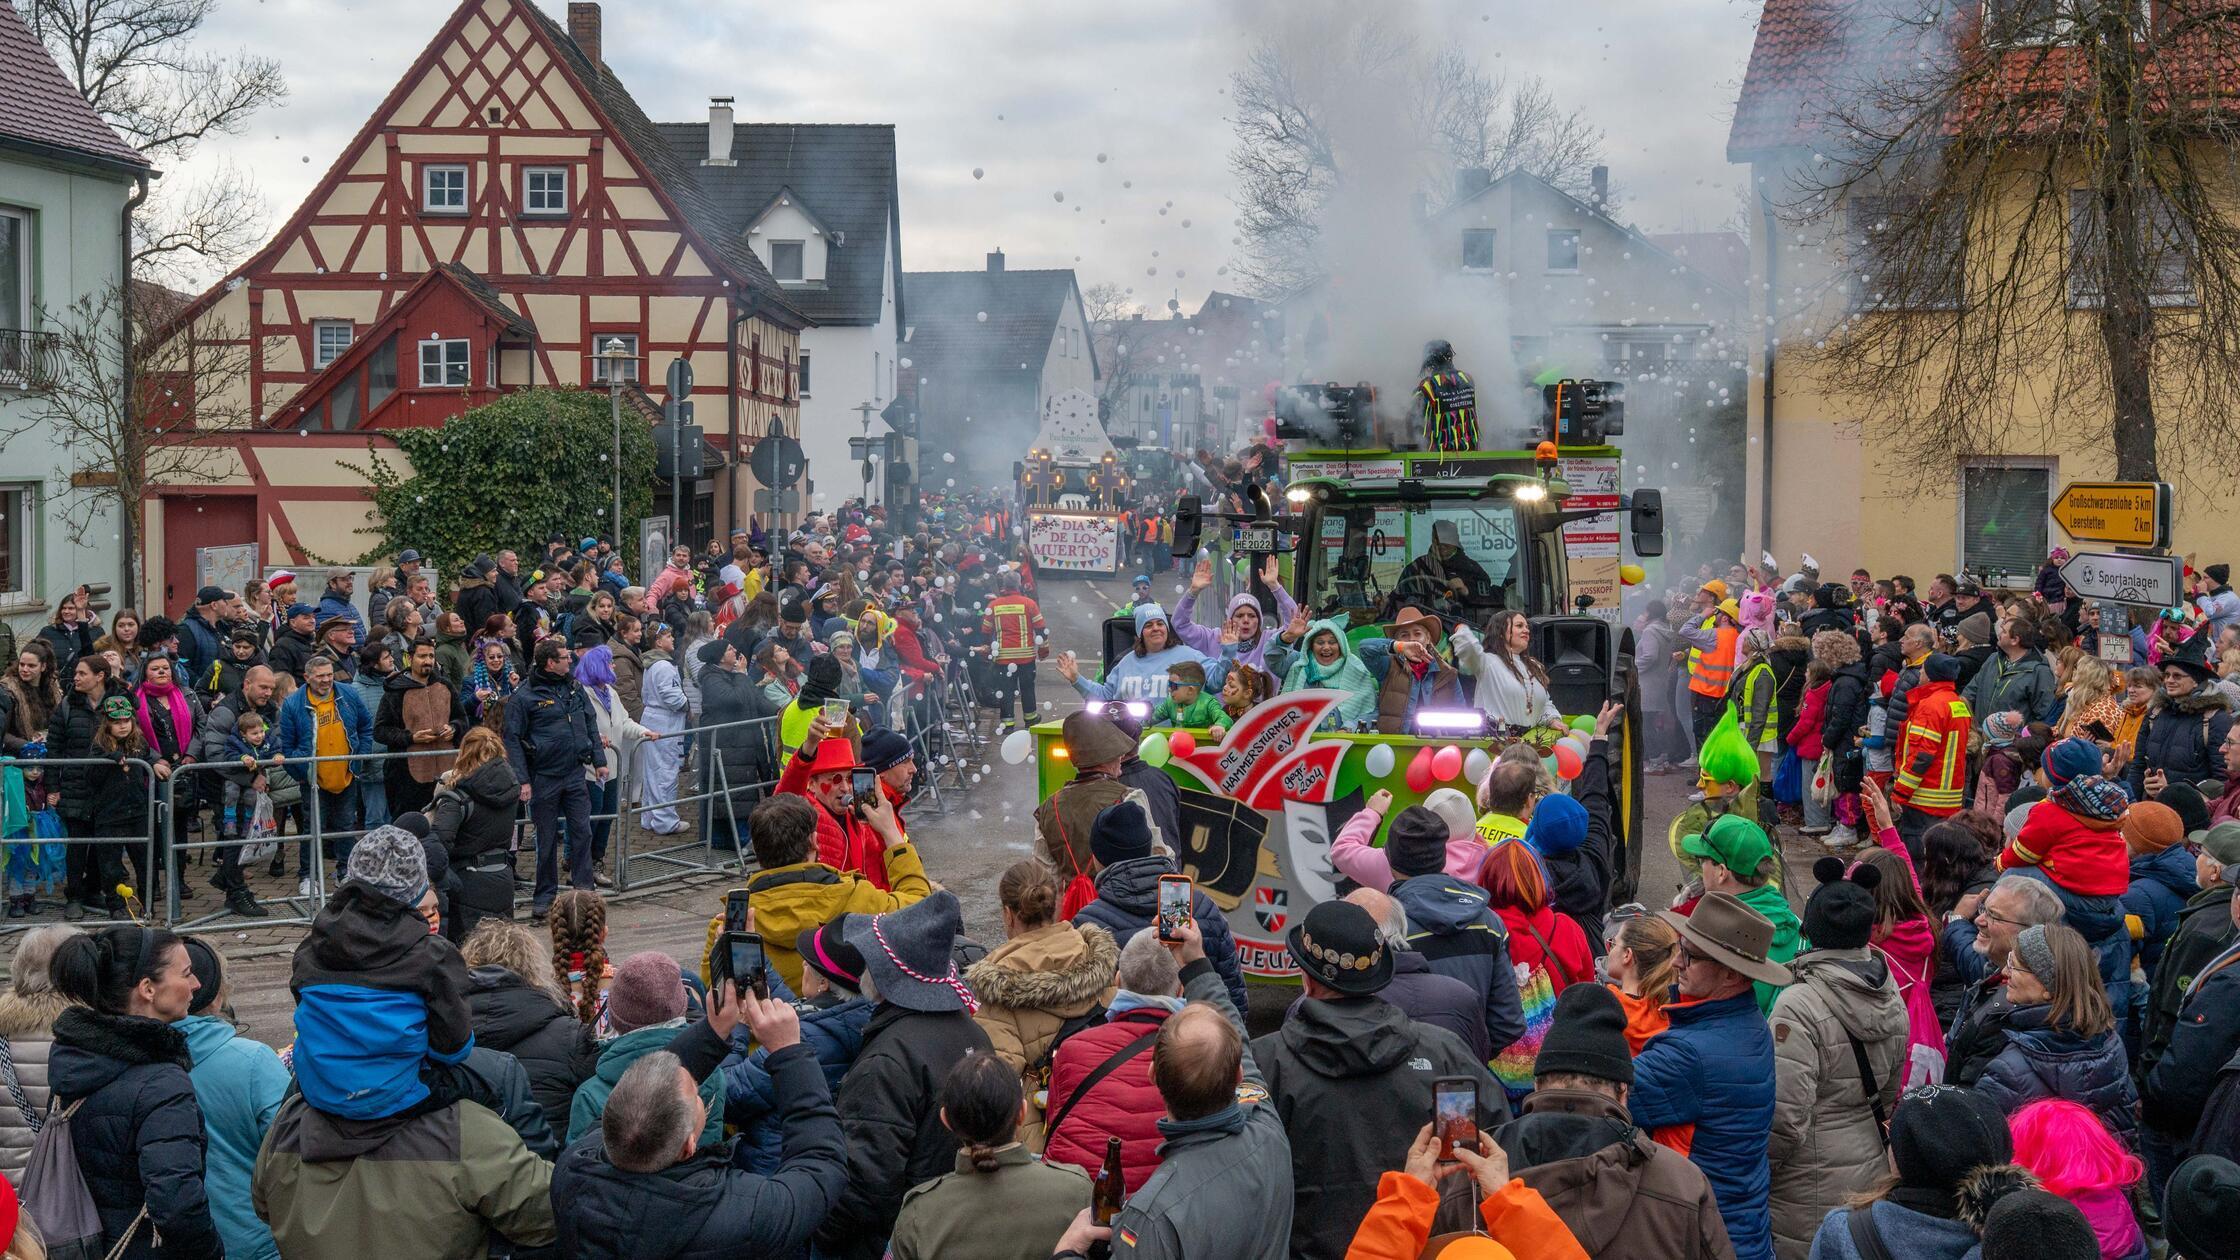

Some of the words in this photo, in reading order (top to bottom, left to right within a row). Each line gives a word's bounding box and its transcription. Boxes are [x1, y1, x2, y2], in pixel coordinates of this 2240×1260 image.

[1367, 466, 1402, 475] Spezialitäten
[2069, 494, 2132, 510] Großschwarzenlohe
[2135, 499, 2140, 510] 5
[2140, 499, 2151, 511] km
[1062, 520, 1085, 531] DIA
[1457, 517, 1515, 536] EINER
[2069, 515, 2105, 530] Leerstetten
[2134, 517, 2139, 531] 2
[2139, 517, 2151, 532] km
[1050, 532, 1068, 543] DE
[1073, 533, 1097, 544] LOS
[1242, 531, 1254, 540] RH
[1481, 535, 1515, 550] bau
[1033, 543, 1109, 558] MUERTOS
[1235, 541, 1247, 549] HE
[1248, 540, 1272, 550] 2022
[2098, 570, 2159, 591] Sportanlagen
[1580, 585, 1613, 594] ROSSKOPF
[1222, 709, 1301, 793] HAMMERSTÜRMER
[1276, 735, 1296, 753] e.V.
[1219, 753, 1239, 770] DIE
[1283, 762, 1307, 790] gegr.
[1299, 766, 1326, 796] 2004
